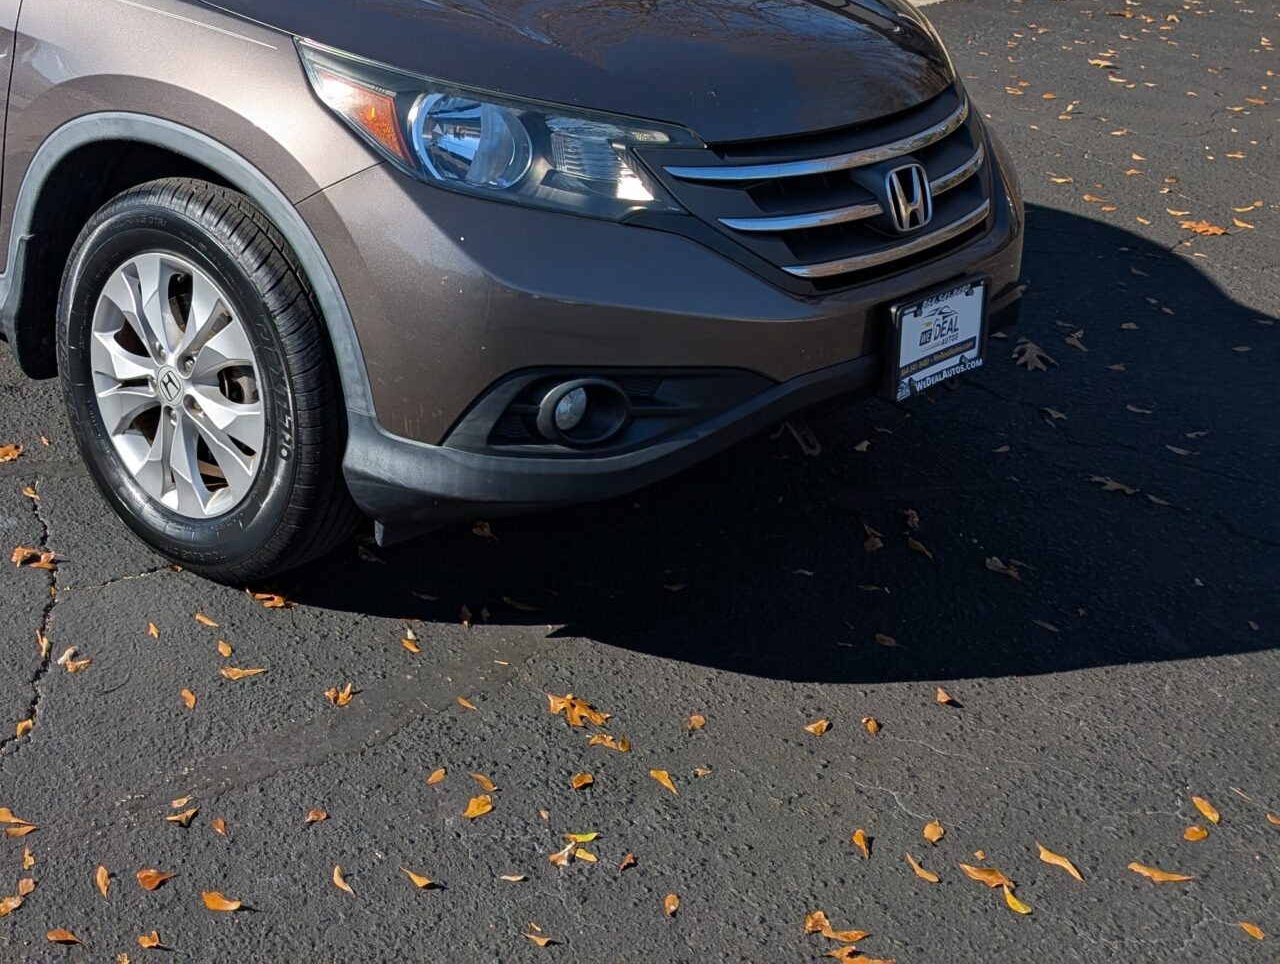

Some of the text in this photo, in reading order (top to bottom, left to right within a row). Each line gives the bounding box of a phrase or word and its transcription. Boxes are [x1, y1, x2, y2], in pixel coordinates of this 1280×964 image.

[920, 316, 959, 345] WE DEAL
[940, 333, 959, 347] AUTOS
